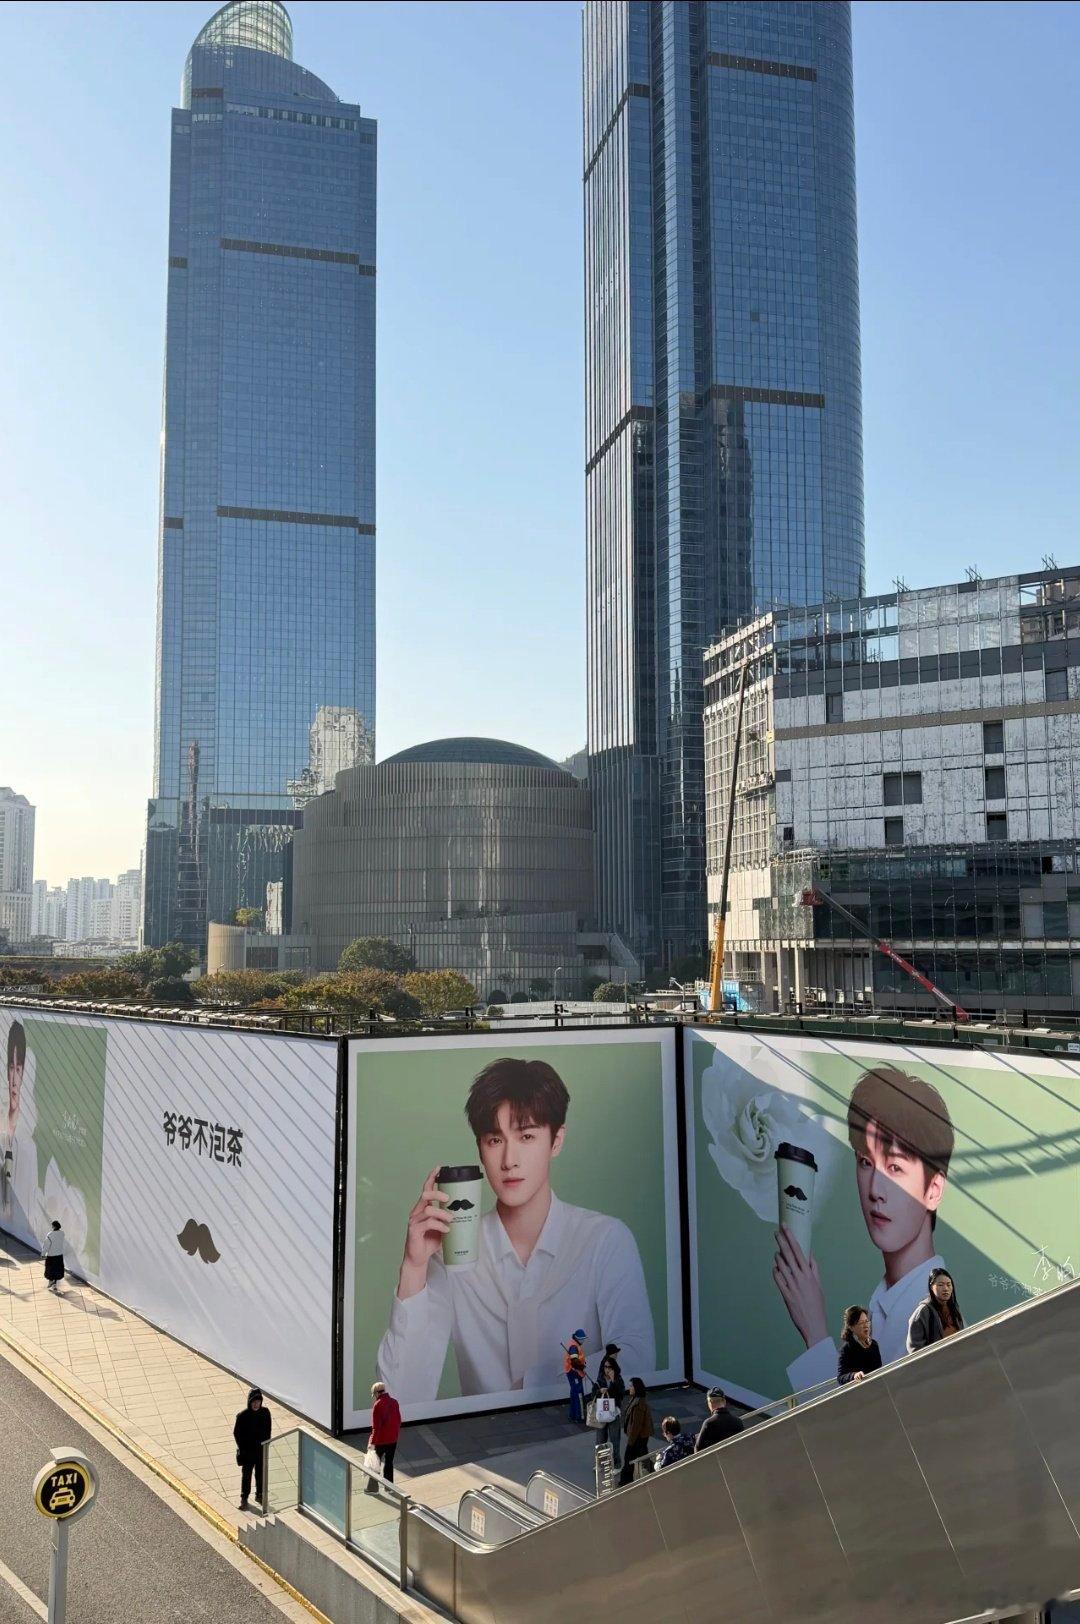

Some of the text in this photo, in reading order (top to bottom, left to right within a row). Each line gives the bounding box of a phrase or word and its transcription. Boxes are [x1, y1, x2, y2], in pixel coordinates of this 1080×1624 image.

[163, 1110, 244, 1168] 爷爷不泡茶
[51, 1472, 78, 1487] TAXI
